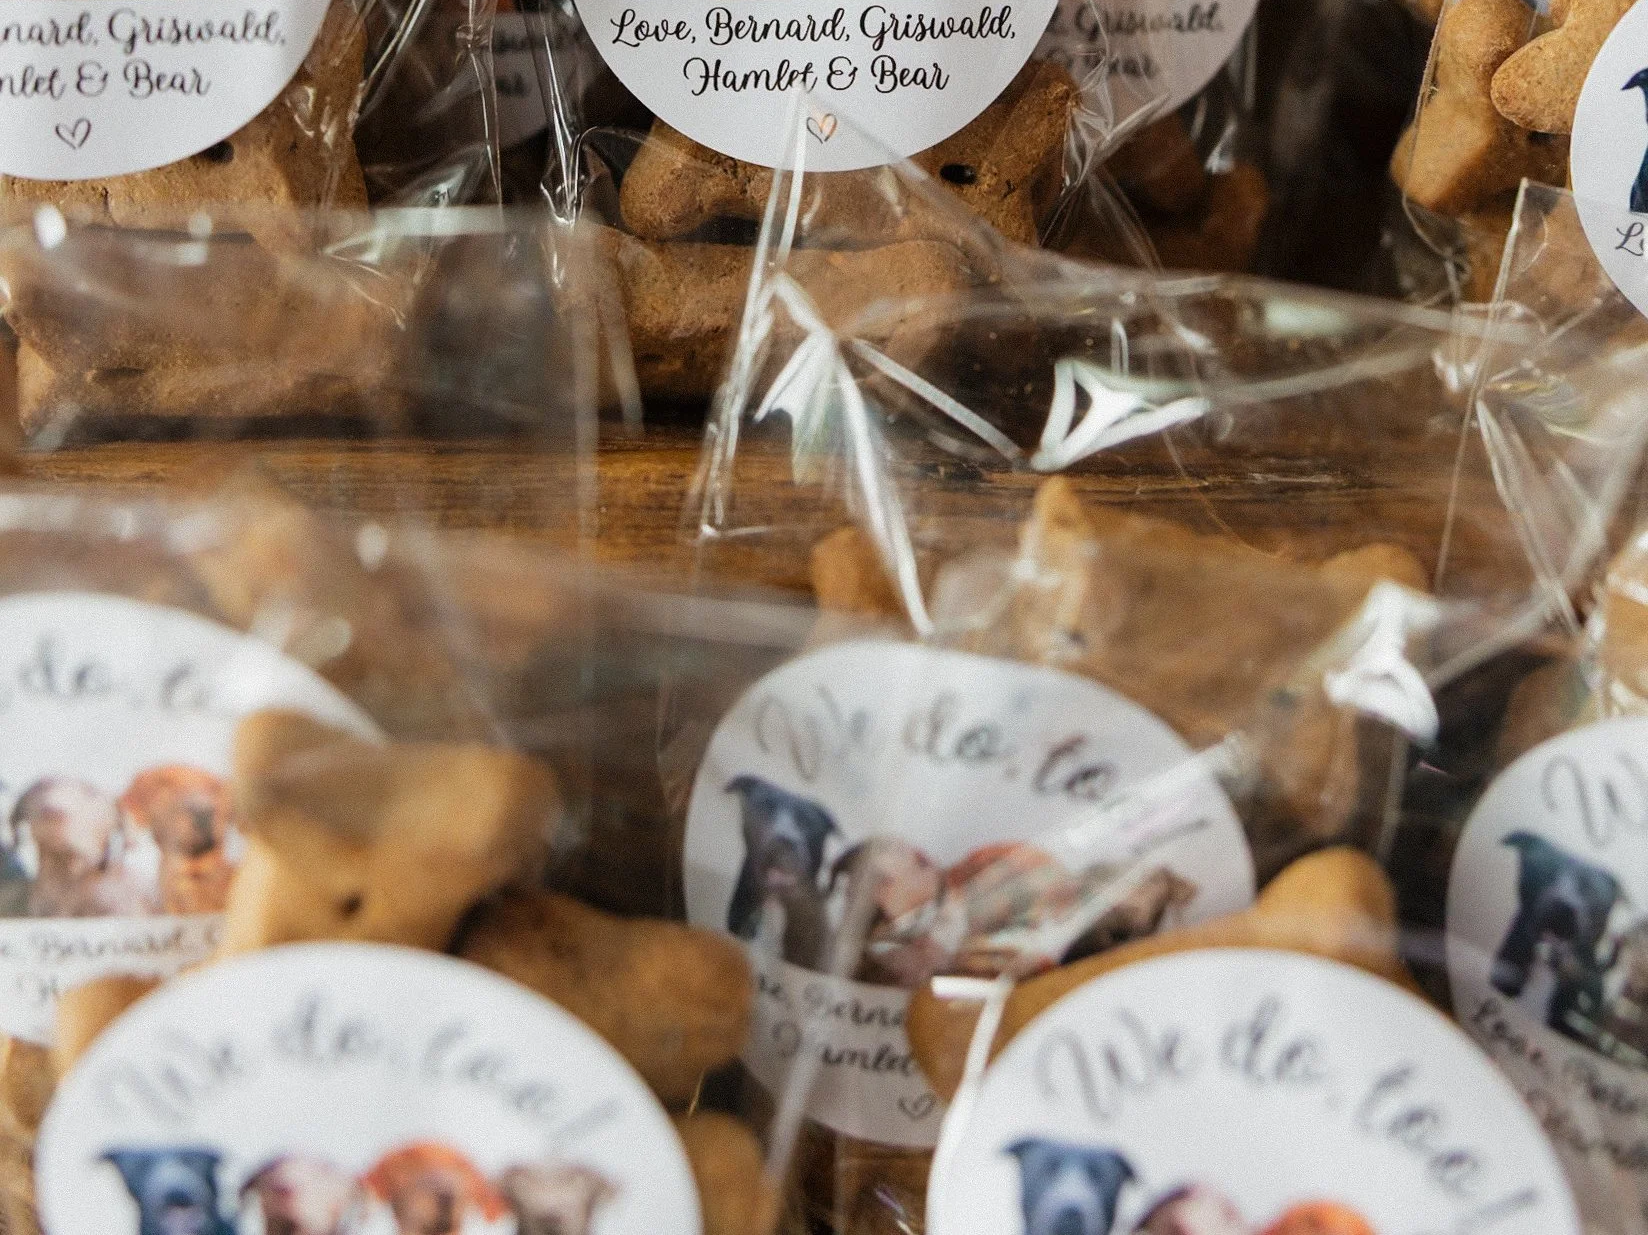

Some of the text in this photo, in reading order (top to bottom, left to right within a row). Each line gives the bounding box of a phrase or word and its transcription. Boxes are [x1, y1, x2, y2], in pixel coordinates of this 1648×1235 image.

[108, 7, 287, 54] Griswald,
[610, 8, 697, 48] Love,
[706, 7, 851, 46] Bernard,
[860, 5, 1016, 51] Griswald,
[76, 60, 109, 97] &
[123, 59, 212, 100] Bear
[682, 55, 951, 96] Hamlet & Bear
